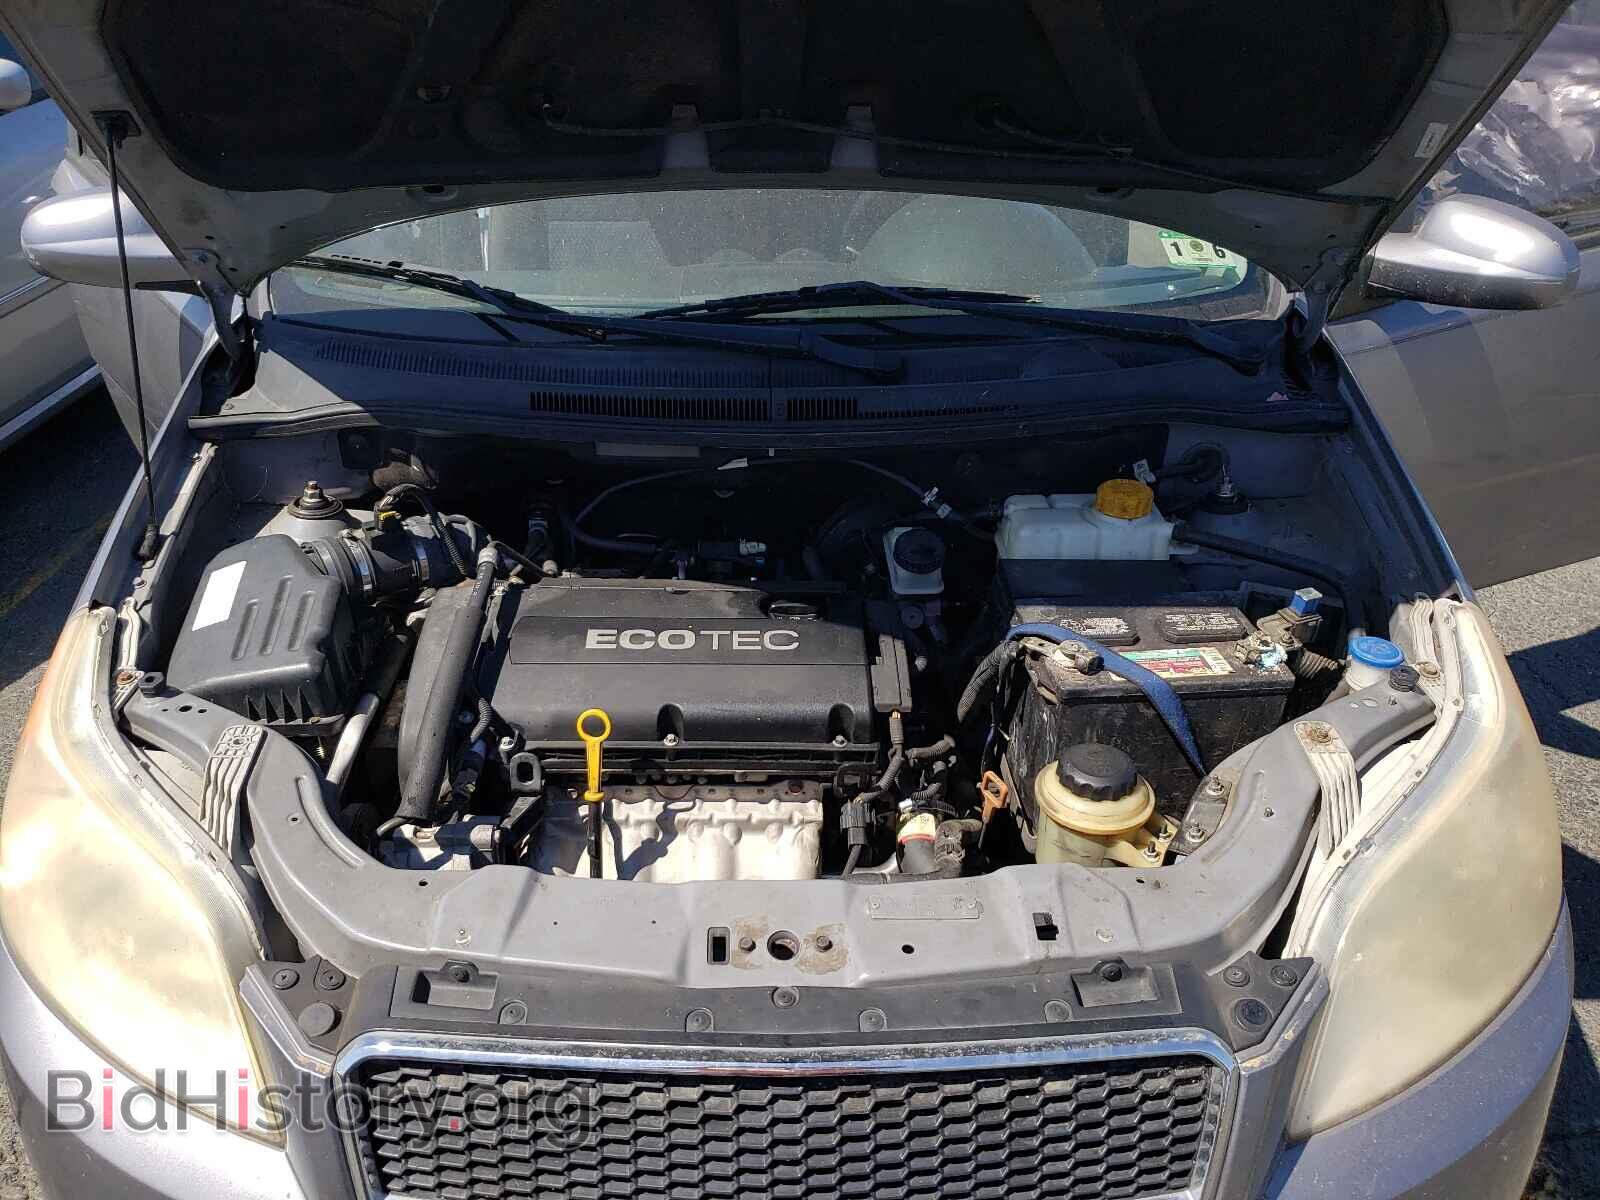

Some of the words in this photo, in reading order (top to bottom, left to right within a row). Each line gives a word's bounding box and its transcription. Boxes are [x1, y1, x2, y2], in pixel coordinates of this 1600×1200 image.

[1170, 241, 1183, 256] 1
[1212, 243, 1226, 258] 6
[585, 629, 800, 651] ECOTEC
